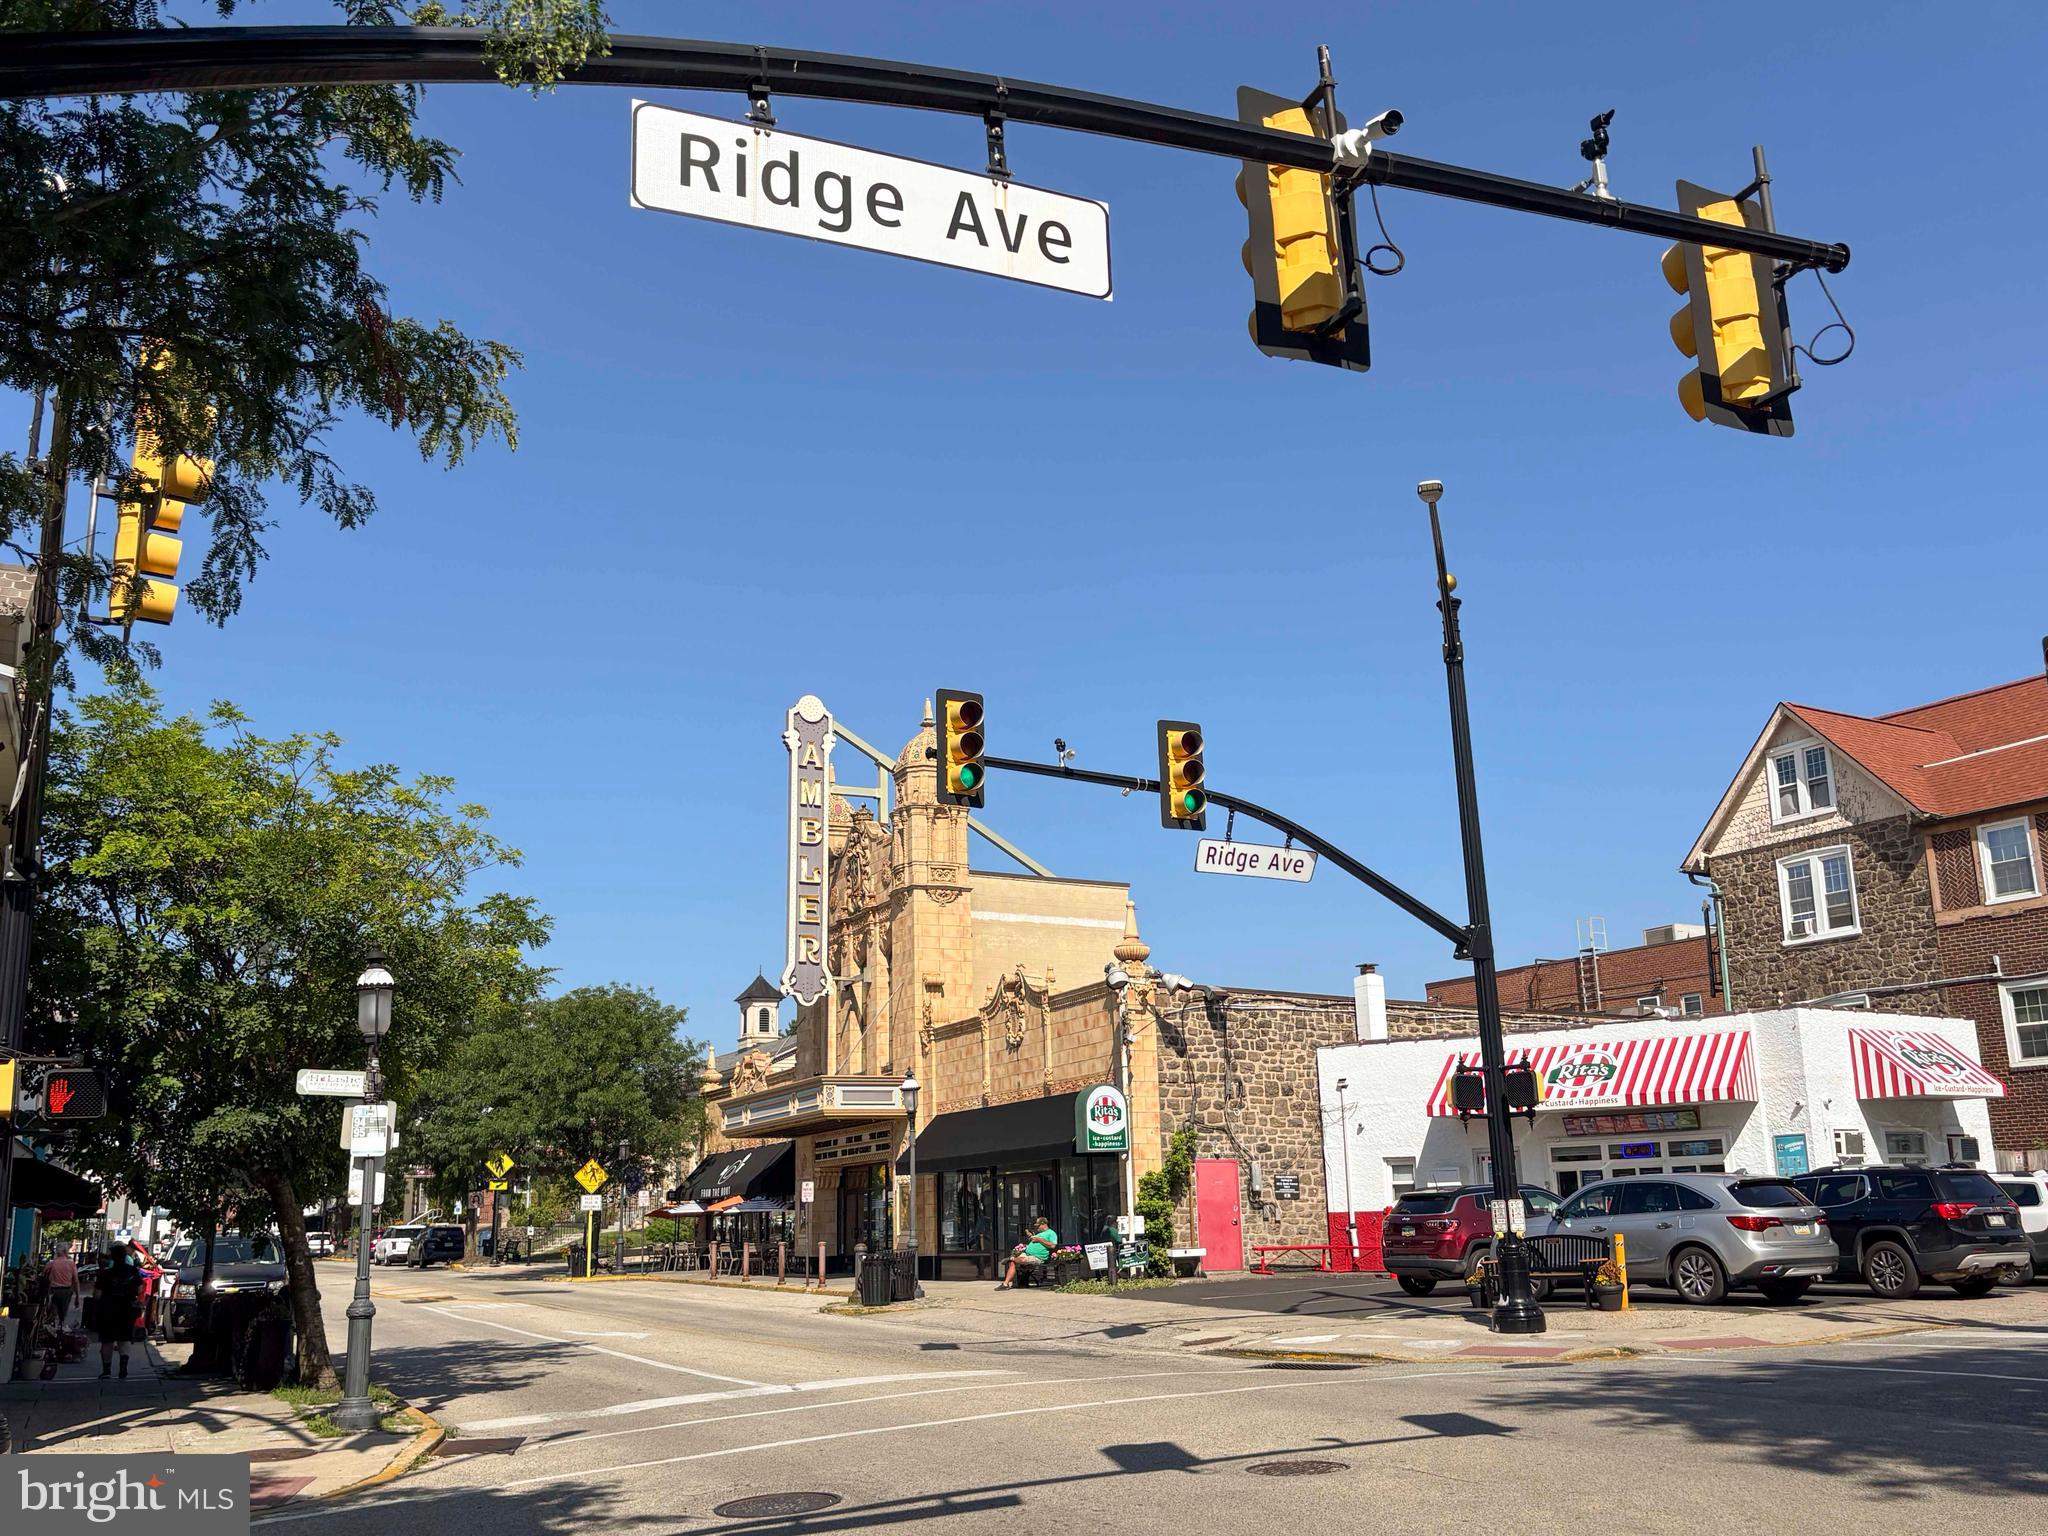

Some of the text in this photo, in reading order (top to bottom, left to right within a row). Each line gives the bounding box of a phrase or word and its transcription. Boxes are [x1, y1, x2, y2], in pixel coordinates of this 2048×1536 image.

[679, 132, 1072, 264] Ridge Ave
[798, 741, 824, 966] AMBLER
[1206, 846, 1305, 873] Ridge Ave
[1558, 1063, 1609, 1080] Rita's
[1578, 1097, 1619, 1106] Happiness
[1094, 1104, 1119, 1118] Rita's
[353, 1117, 366, 1127] 94
[353, 1128, 366, 1138] 95
